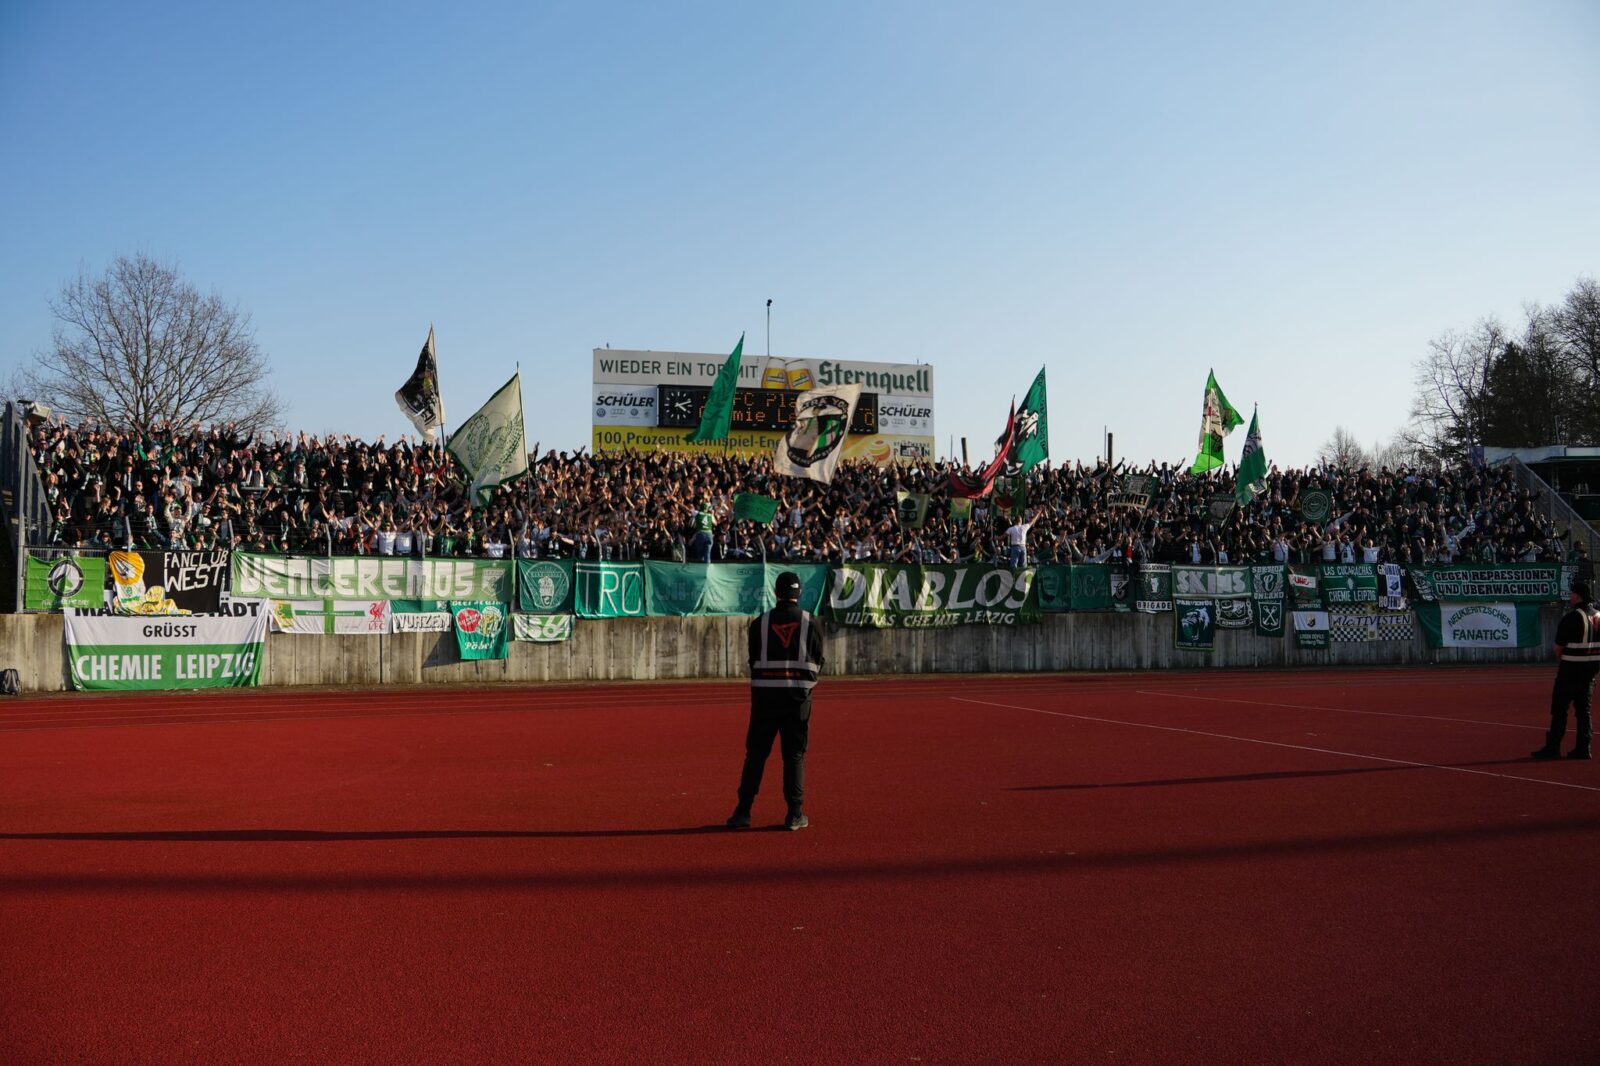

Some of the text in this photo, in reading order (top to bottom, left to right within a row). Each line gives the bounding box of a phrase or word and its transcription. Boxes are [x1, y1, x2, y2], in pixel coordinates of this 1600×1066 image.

[600, 359, 661, 375] WIEDER
[667, 361, 692, 376] EIN
[818, 360, 929, 394] Sternquell
[595, 393, 655, 408] SCHÜLER
[879, 404, 931, 418] SCHÜLER
[596, 431, 622, 444] 100
[626, 431, 681, 446] Prozent
[164, 550, 229, 569] FANCLUB
[163, 564, 223, 592] WEST
[1323, 565, 1336, 575] LAS
[1337, 565, 1373, 576] CUCARACHAS
[1434, 568, 1556, 583] GEGEN REPRESSIONEN
[830, 567, 1037, 611] DIABLOS
[1176, 570, 1246, 593] SKINS
[1437, 583, 1460, 596] UND
[1463, 582, 1549, 597] ÜBERWACHUNG
[1328, 590, 1351, 602] CHEMIE
[1353, 589, 1377, 601] LEIPZIG
[1137, 601, 1172, 610] BRIGADE
[396, 612, 451, 630] WURZEN
[845, 610, 1016, 628] ULTRAS CHEMIE LEIPZIG
[143, 622, 197, 638] GRÜSST
[1452, 629, 1509, 641] FANATICS
[76, 650, 255, 681] CHEMIE LEIPZIG
